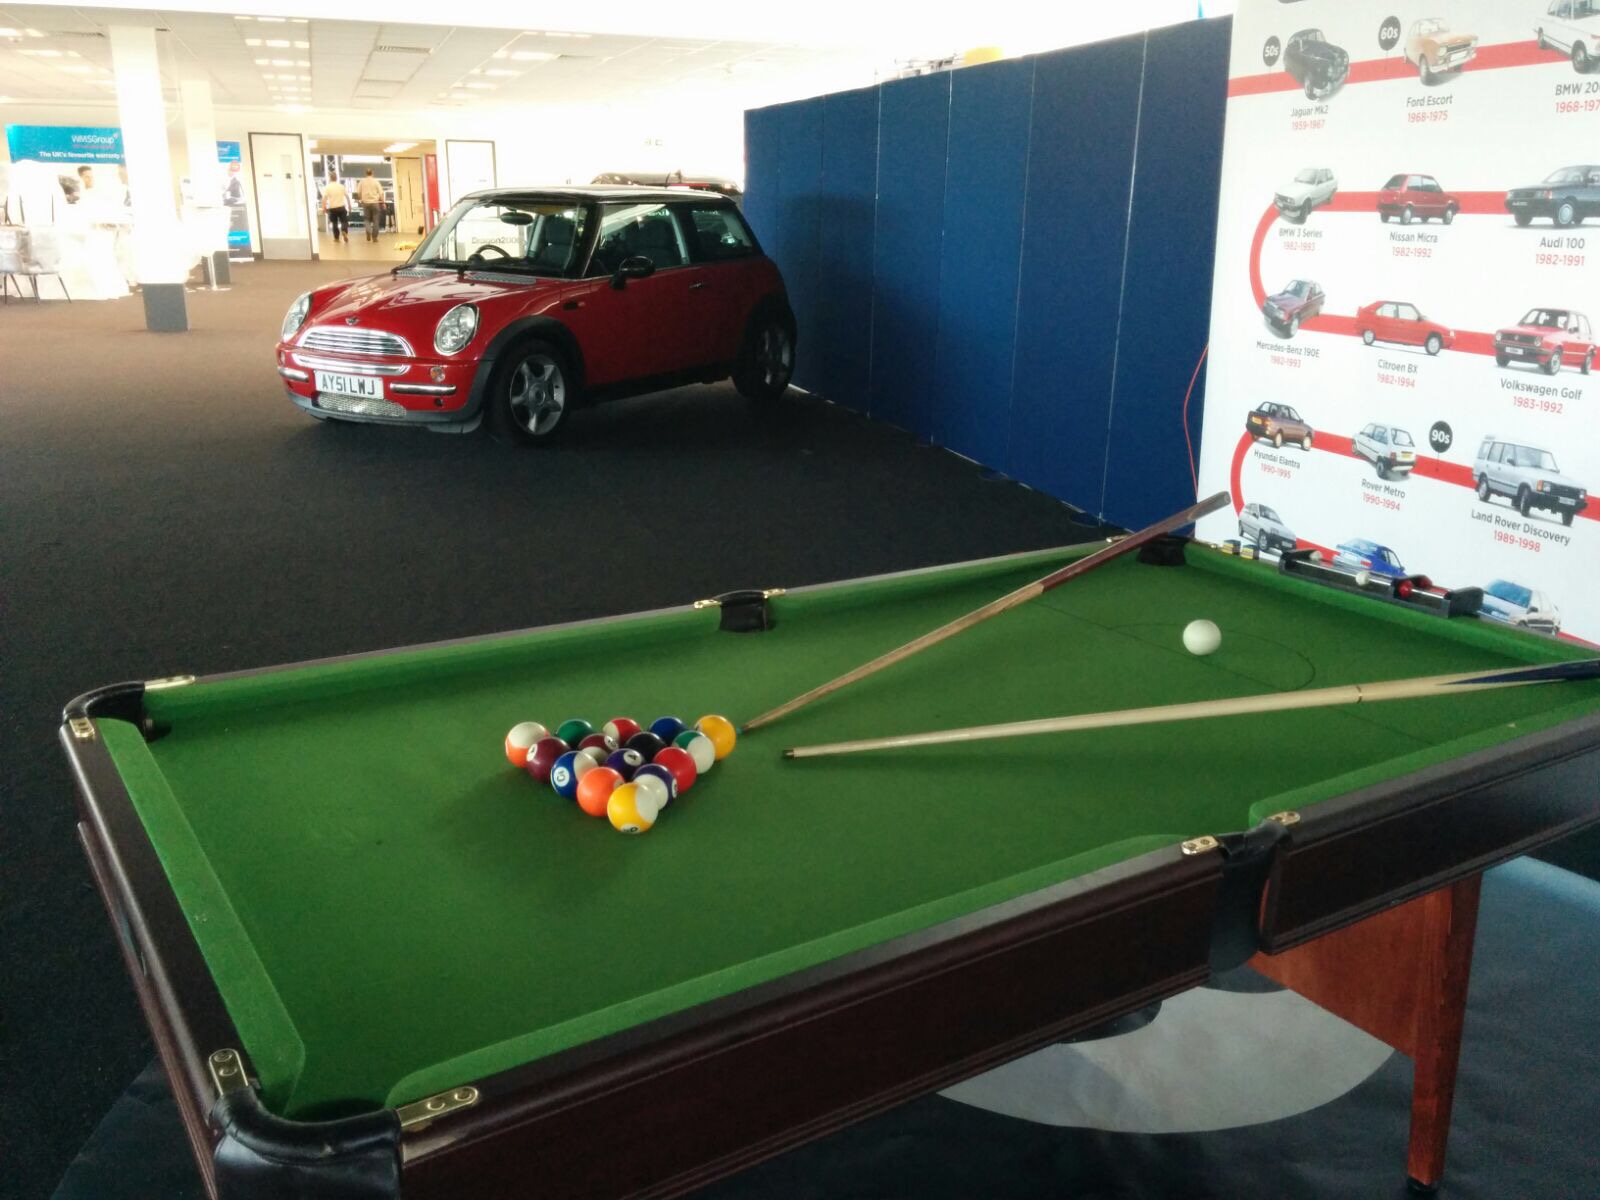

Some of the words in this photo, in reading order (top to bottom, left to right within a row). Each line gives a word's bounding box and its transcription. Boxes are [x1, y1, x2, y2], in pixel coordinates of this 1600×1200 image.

[1380, 26, 1399, 40] 60s
[1263, 45, 1279, 57] 50s
[1555, 83, 1582, 96] BMW
[1584, 81, 1600, 94] 20
[1406, 96, 1425, 107] Ford
[1427, 94, 1453, 106] Escort
[1555, 99, 1600, 113] 1968-197
[1291, 106, 1313, 117] Jaguar
[1315, 105, 1329, 114] Mk2
[1407, 110, 1448, 122] 1968-1975
[1279, 228, 1295, 237] BMW
[1302, 229, 1323, 238] Series
[1389, 231, 1415, 241] Nissan
[1416, 232, 1438, 243] Micra
[1540, 237, 1563, 248] Audi
[1566, 237, 1585, 249] 100
[1392, 246, 1432, 258] 1982-1992
[1535, 253, 1585, 266] 1982-1991
[1256, 340, 1302, 355] Mercedes-Benz
[1303, 346, 1320, 358] 190E
[1378, 359, 1406, 372] Citroen
[1407, 363, 1418, 374] BX
[1500, 378, 1558, 397] Volkswagen
[1561, 387, 1583, 400] Golf
[1513, 396, 1563, 414] 1983-1992
[1431, 429, 1450, 444] 90s
[1254, 449, 1278, 463] Hyundai
[1279, 456, 1301, 469] Elantra
[1361, 479, 1382, 492] Rover
[1384, 484, 1405, 499] Metro
[1362, 492, 1400, 511] 1990-1994
[1471, 509, 1492, 523] Land
[1494, 515, 1520, 531] Rover
[1523, 523, 1570, 546] Discovery
[1494, 530, 1541, 552] 1989-1998
